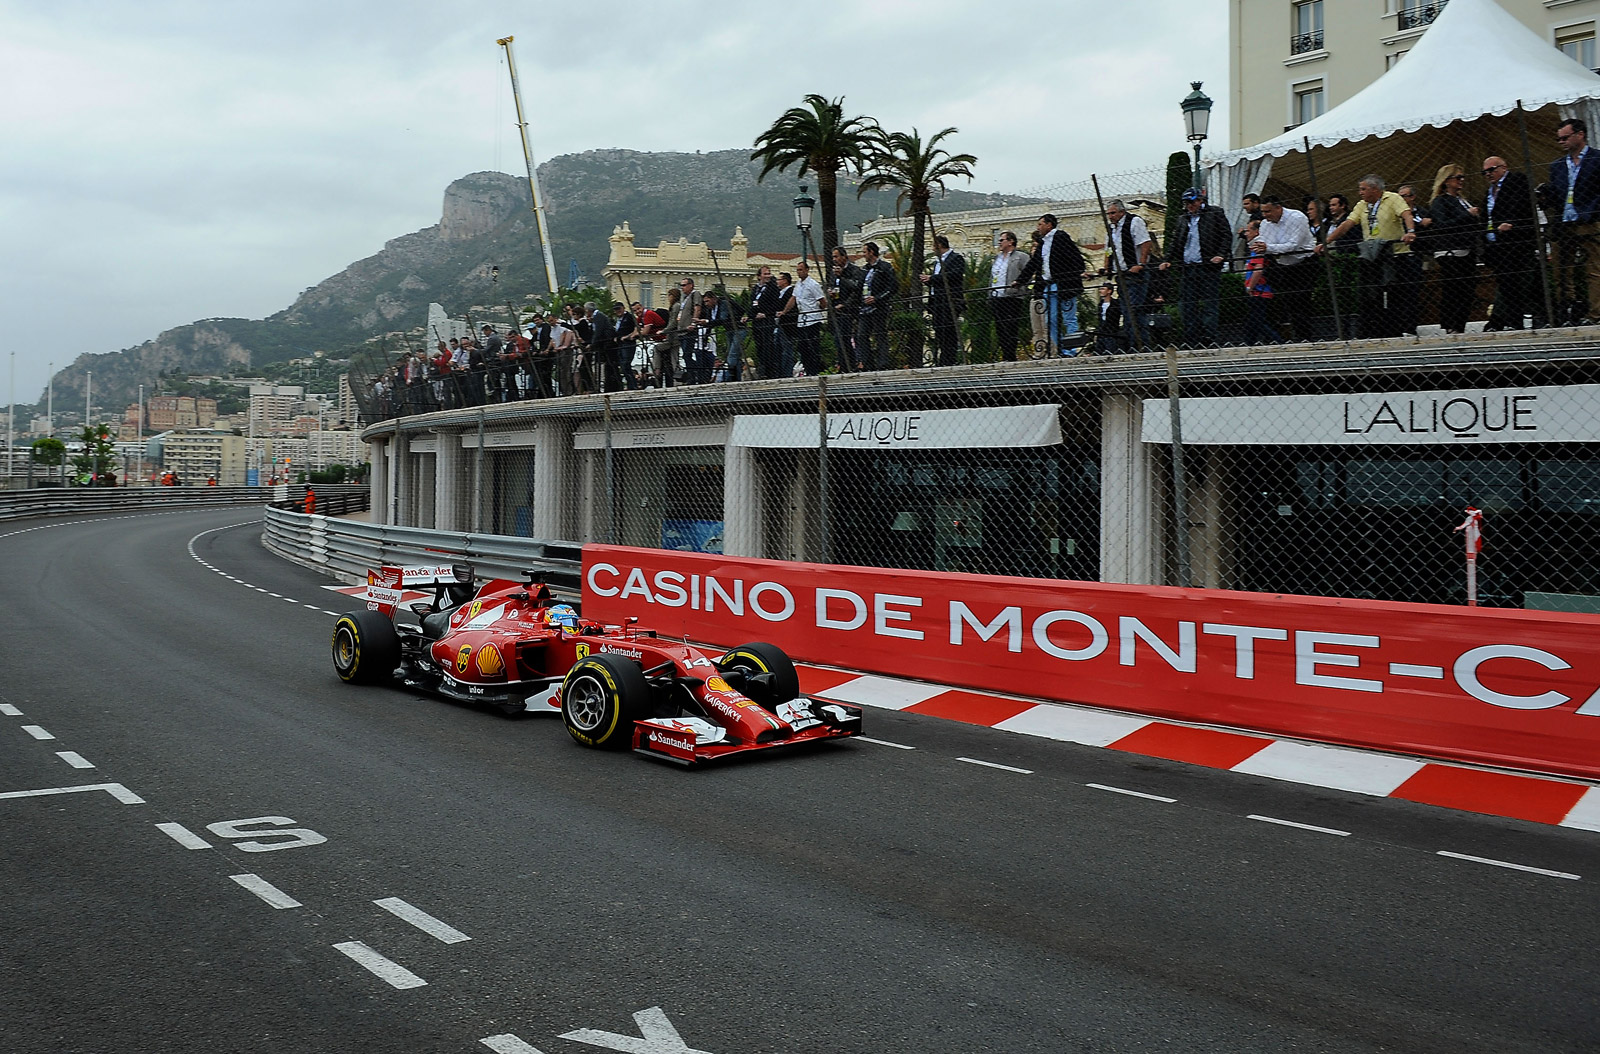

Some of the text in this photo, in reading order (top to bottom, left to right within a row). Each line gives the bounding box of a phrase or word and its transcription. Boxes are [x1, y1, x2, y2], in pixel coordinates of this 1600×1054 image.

[1343, 395, 1538, 439] LALIQUE
[826, 416, 921, 445] LALIQUE
[587, 562, 796, 622] CASINO
[815, 587, 925, 641] DE
[608, 645, 643, 659] Santander
[682, 656, 712, 670] 14
[657, 733, 694, 751] Santander
